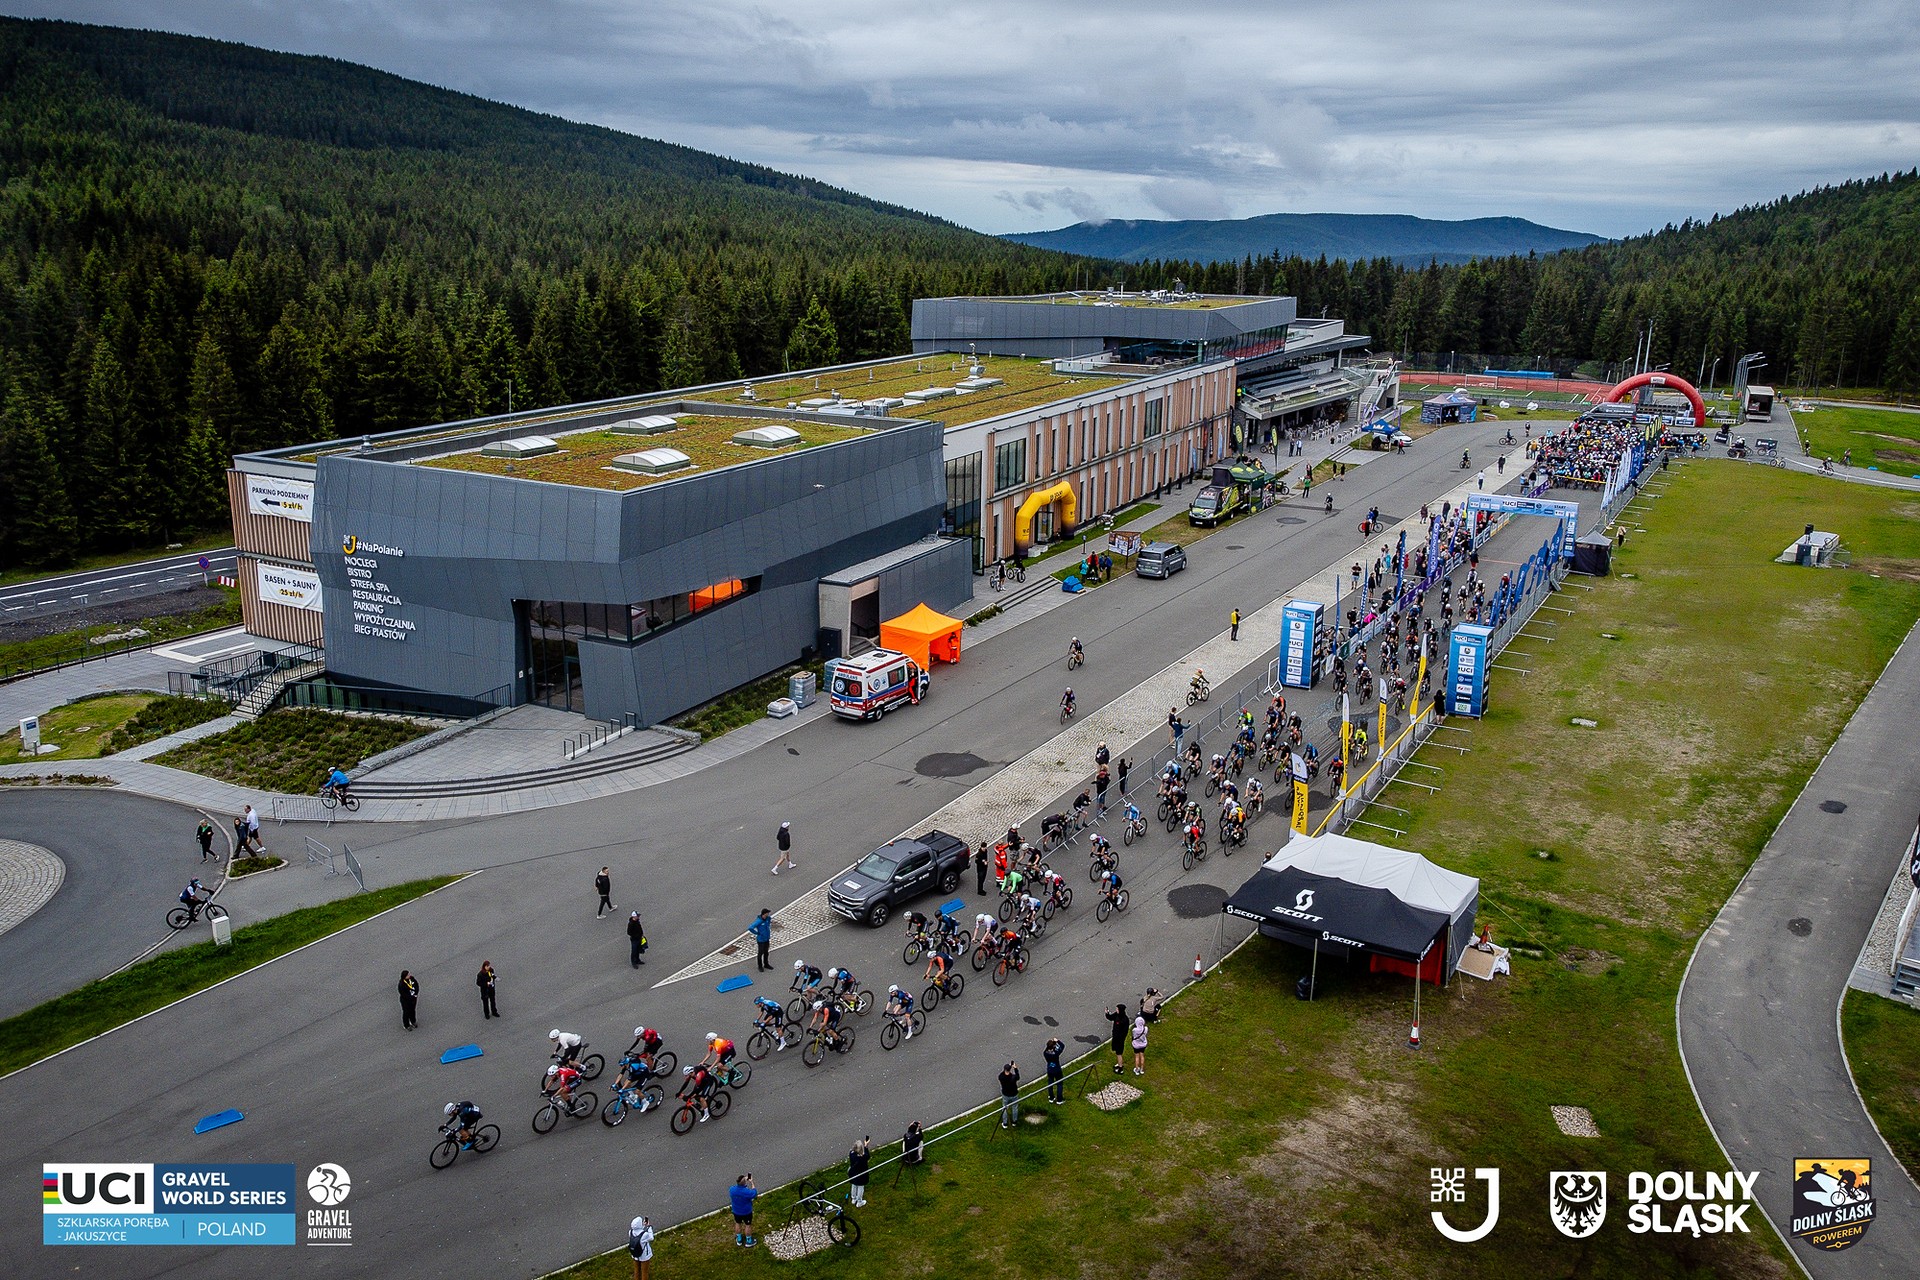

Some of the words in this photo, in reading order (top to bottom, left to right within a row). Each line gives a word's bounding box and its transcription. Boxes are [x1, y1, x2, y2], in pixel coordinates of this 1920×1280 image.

[252, 487, 276, 496] PARKING
[277, 490, 309, 500] PODZIEMNY
[356, 541, 404, 557] #NaPolanie
[344, 556, 378, 569] NOCLEGI
[347, 567, 373, 579] BISTRO
[264, 575, 286, 585] BASEN
[292, 580, 316, 590] SAUNY
[350, 579, 376, 590] STREFA
[376, 582, 390, 593] SPA
[352, 589, 402, 606] RESTAURACJA
[353, 600, 384, 614] PARKING
[354, 612, 416, 631] WYPOŻYCZALNIA
[354, 624, 371, 635] BIEG
[372, 628, 406, 641] PIASTÓW
[1233, 909, 1266, 921] SCOTT
[1272, 906, 1323, 922] SCOTT
[1329, 935, 1365, 948] SCOTT
